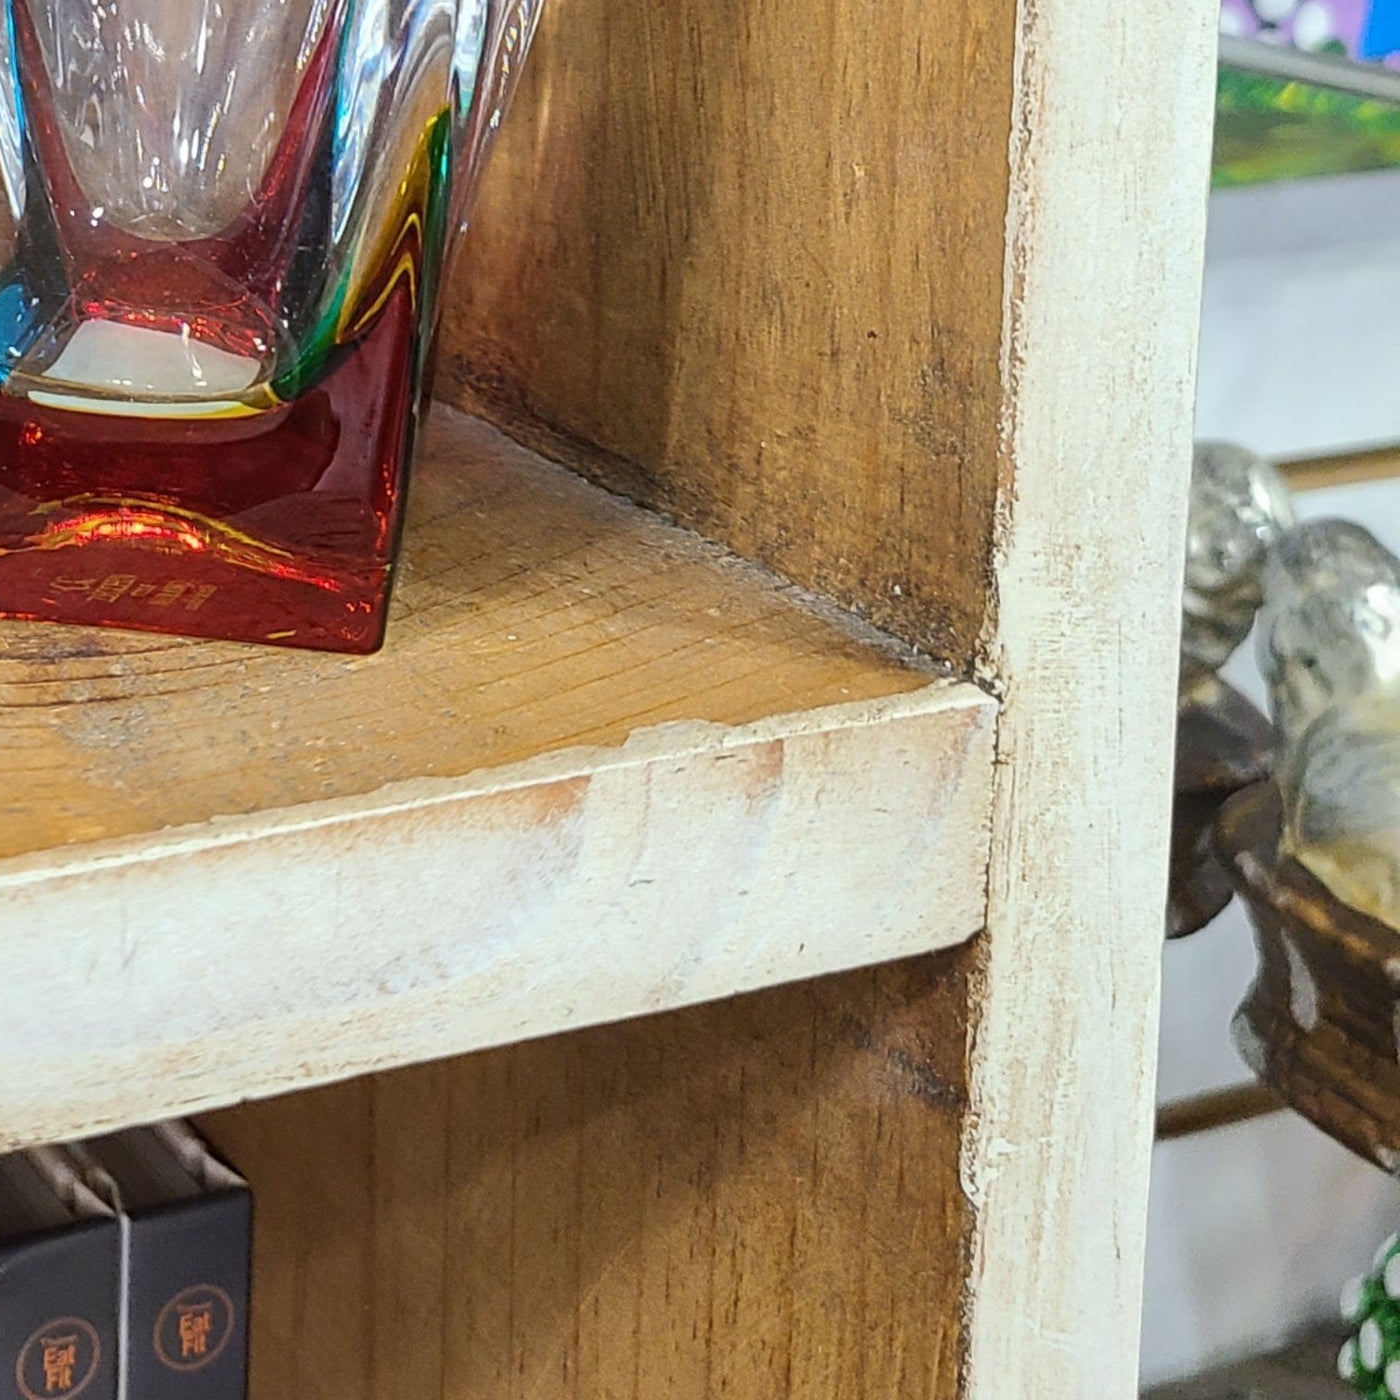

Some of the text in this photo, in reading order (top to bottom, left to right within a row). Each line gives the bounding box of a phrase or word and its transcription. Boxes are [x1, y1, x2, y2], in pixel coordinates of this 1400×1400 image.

[180, 1311, 211, 1335] Eat
[44, 1344, 76, 1369] Eat
[182, 1333, 206, 1356] Fit
[45, 1366, 72, 1392] Fit
